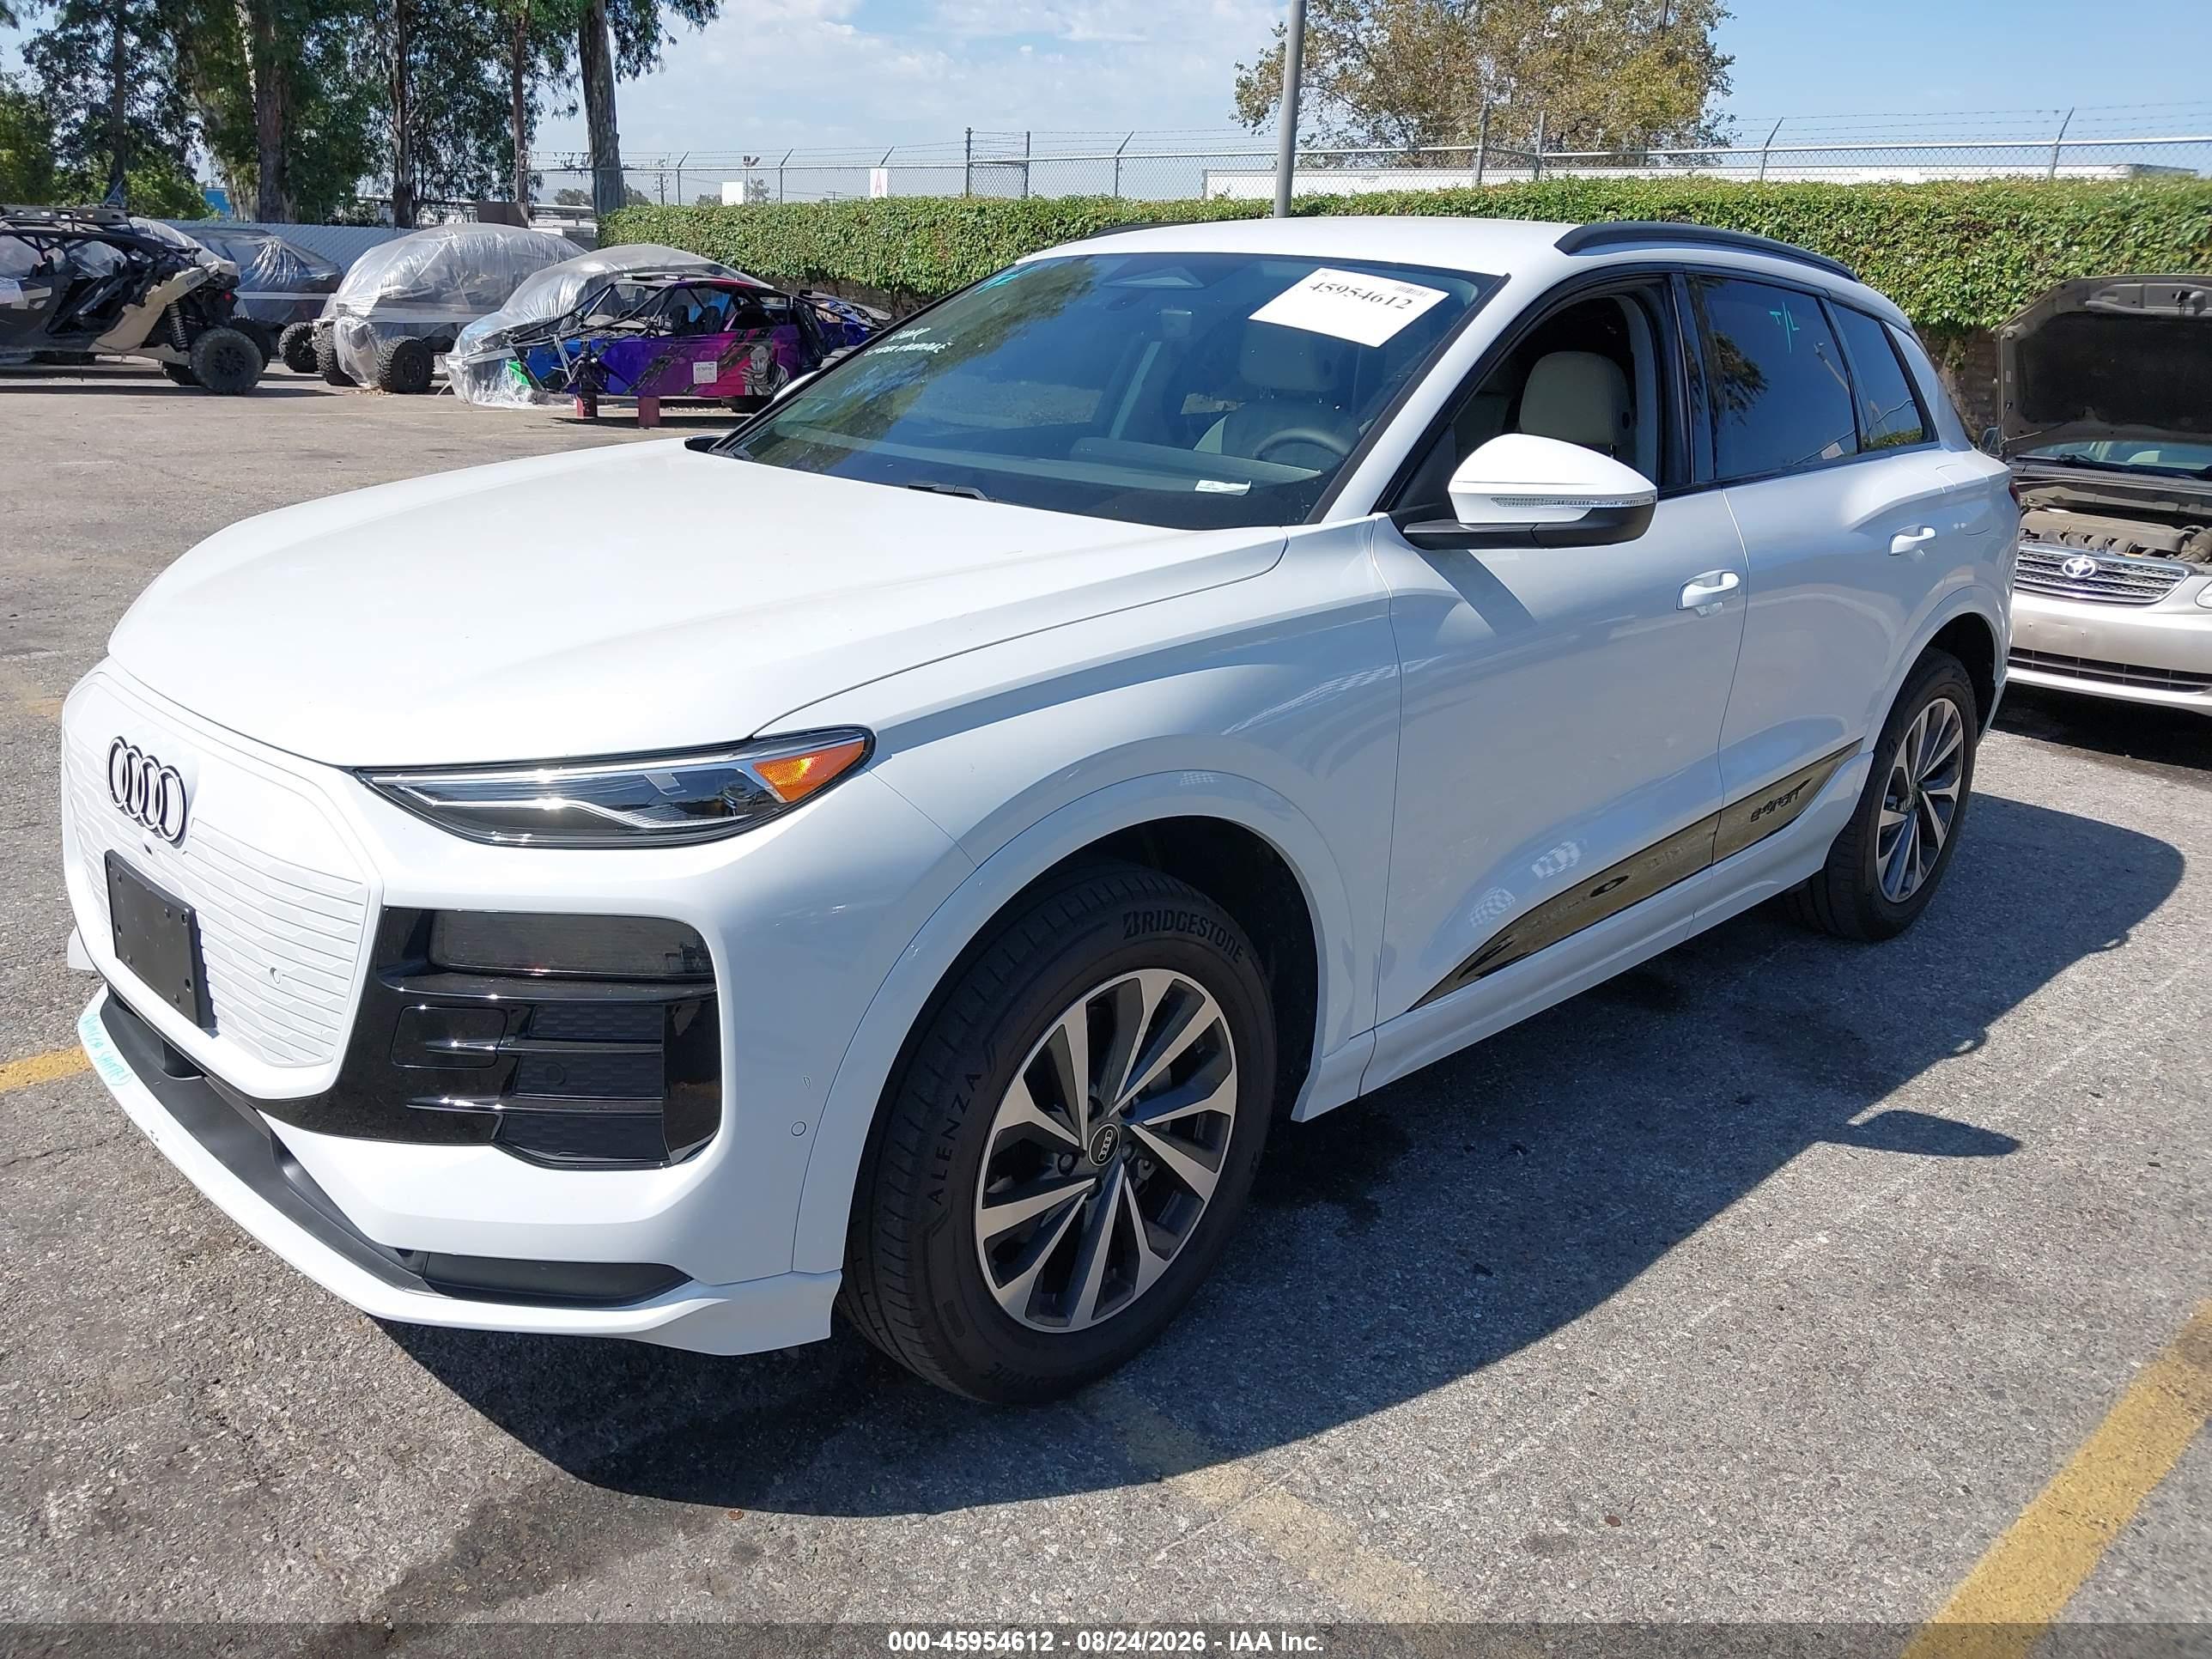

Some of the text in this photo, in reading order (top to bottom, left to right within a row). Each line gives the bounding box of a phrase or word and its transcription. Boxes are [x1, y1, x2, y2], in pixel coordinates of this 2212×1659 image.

[1309, 282, 1413, 310] 45954612
[1122, 909, 1243, 963] BRIDGESTONE
[927, 1073, 983, 1206] ALENZA
